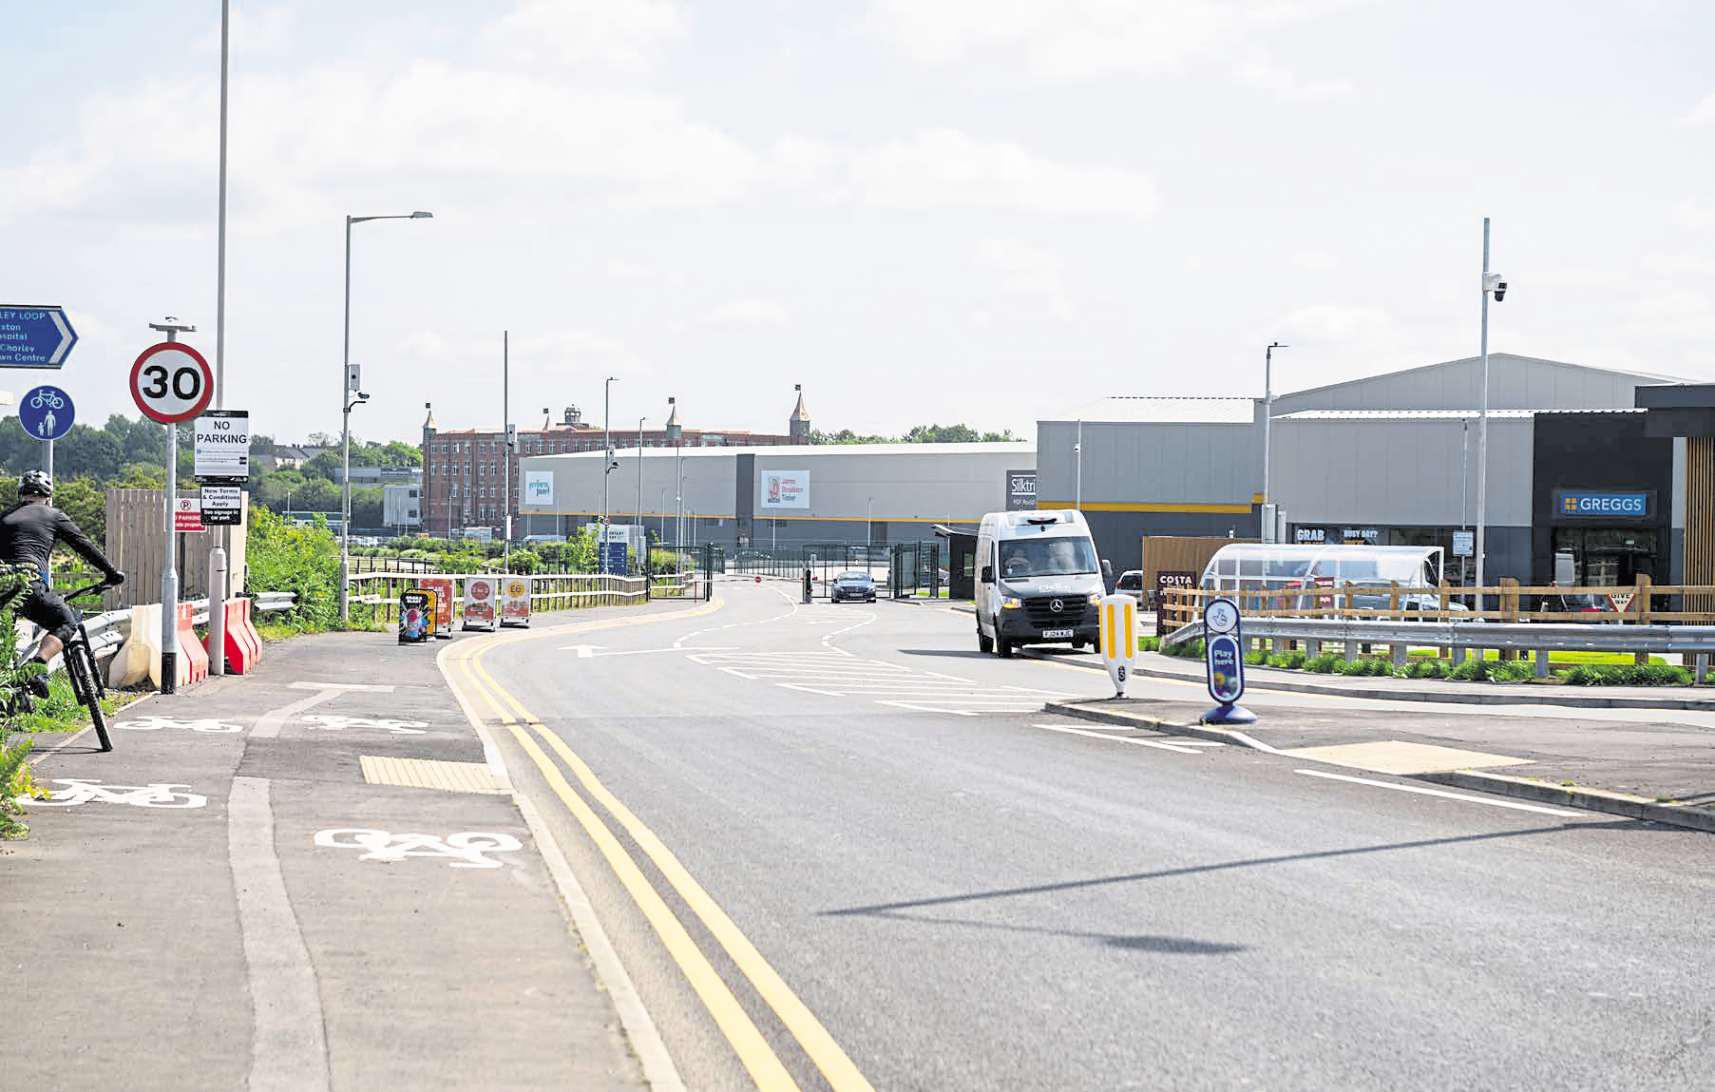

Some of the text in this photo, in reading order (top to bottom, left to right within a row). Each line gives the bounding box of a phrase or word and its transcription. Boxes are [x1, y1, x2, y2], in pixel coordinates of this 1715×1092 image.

[20, 312, 46, 321] LOOP
[15, 353, 46, 362] Centre
[143, 365, 200, 401] 30
[214, 421, 230, 430] NO
[197, 434, 247, 444] PARKING
[1580, 498, 1642, 511] GREGGS
[1297, 529, 1325, 541] GRAB
[1344, 529, 1360, 538] BUSY
[1160, 575, 1192, 584] COSTA
[1215, 650, 1232, 659] Play
